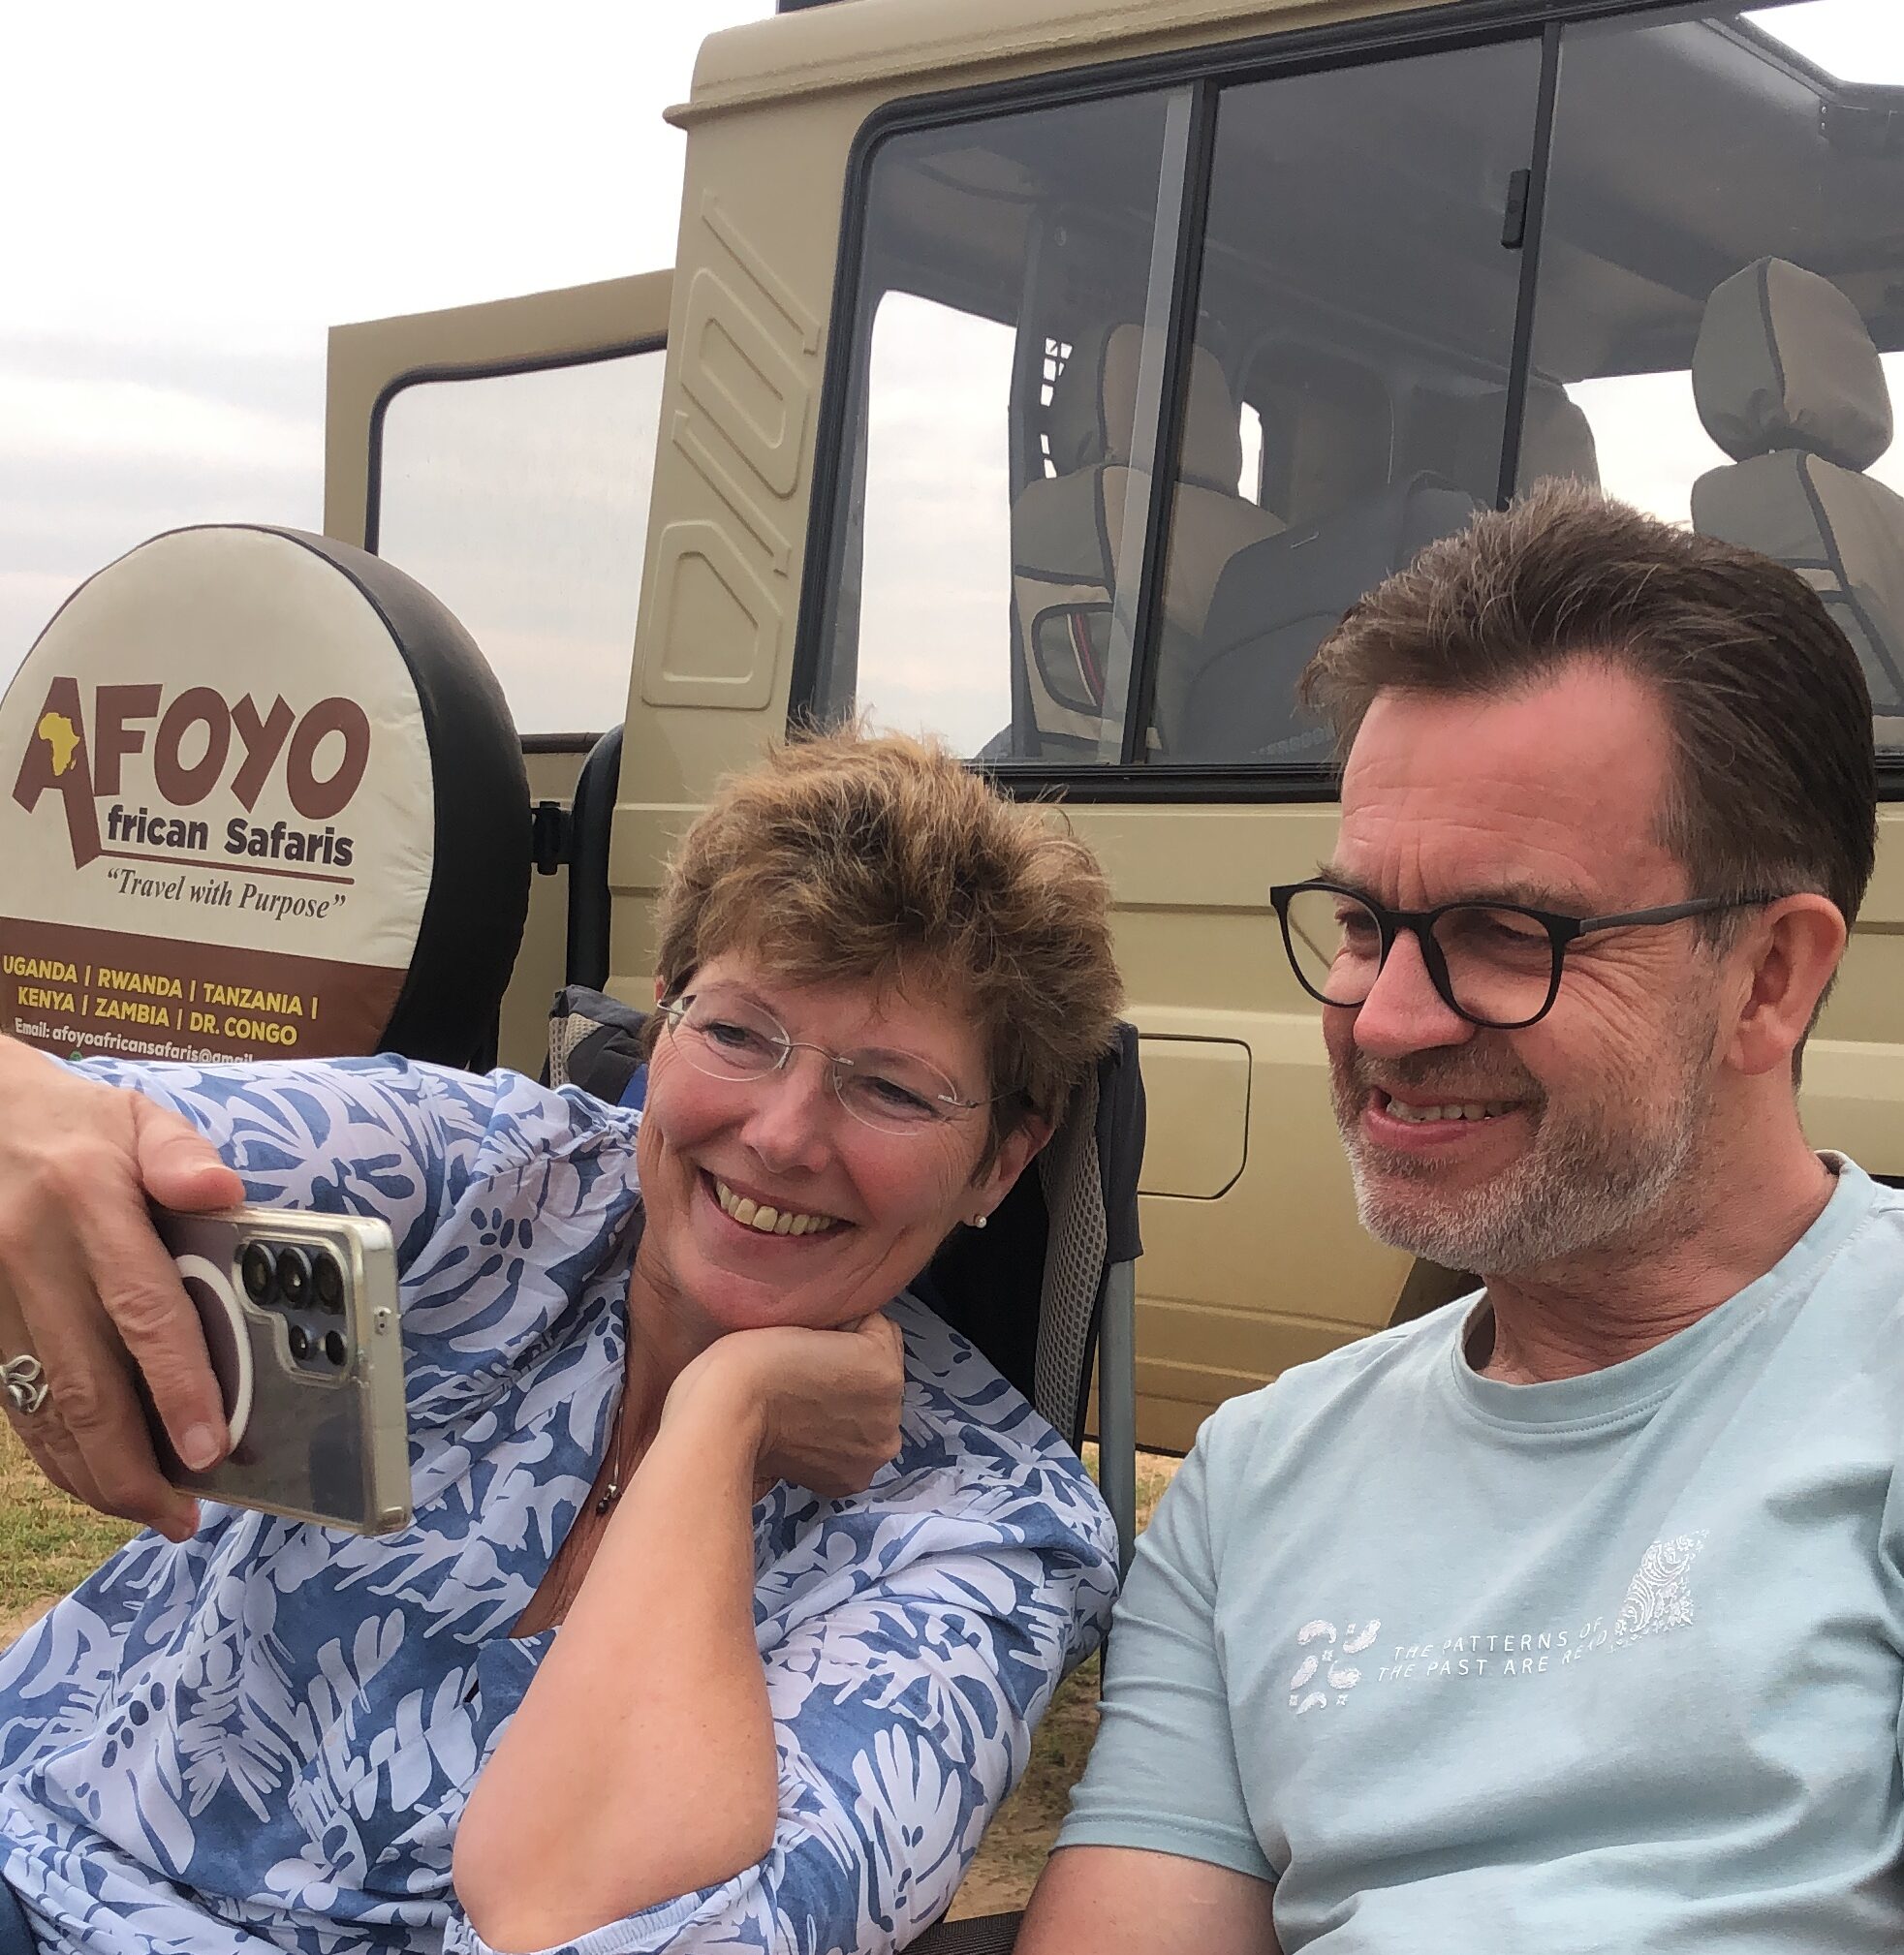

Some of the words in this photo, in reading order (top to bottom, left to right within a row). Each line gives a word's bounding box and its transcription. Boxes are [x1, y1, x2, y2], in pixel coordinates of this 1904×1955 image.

[12, 676, 371, 869] AFOYO
[108, 804, 208, 851] frican
[224, 817, 354, 867] Safaris
[190, 879, 233, 907] with
[3, 954, 78, 983] UGANDA
[98, 968, 182, 999] RWANDA
[203, 982, 303, 1016] TANZANIA
[15, 1017, 49, 1039] Email:
[17, 985, 76, 1013] KENYA
[94, 997, 170, 1027] ZAMBIA
[189, 1011, 220, 1035] DR.
[224, 1017, 297, 1046] CONGO
[1394, 1644, 1433, 1661] THE
[1442, 1630, 1569, 1655] PATTERNS
[1579, 1616, 1604, 1639] OF
[1378, 1663, 1416, 1683] THE
[1426, 1659, 1488, 1677] PAST
[1503, 1656, 1549, 1676] ARE
